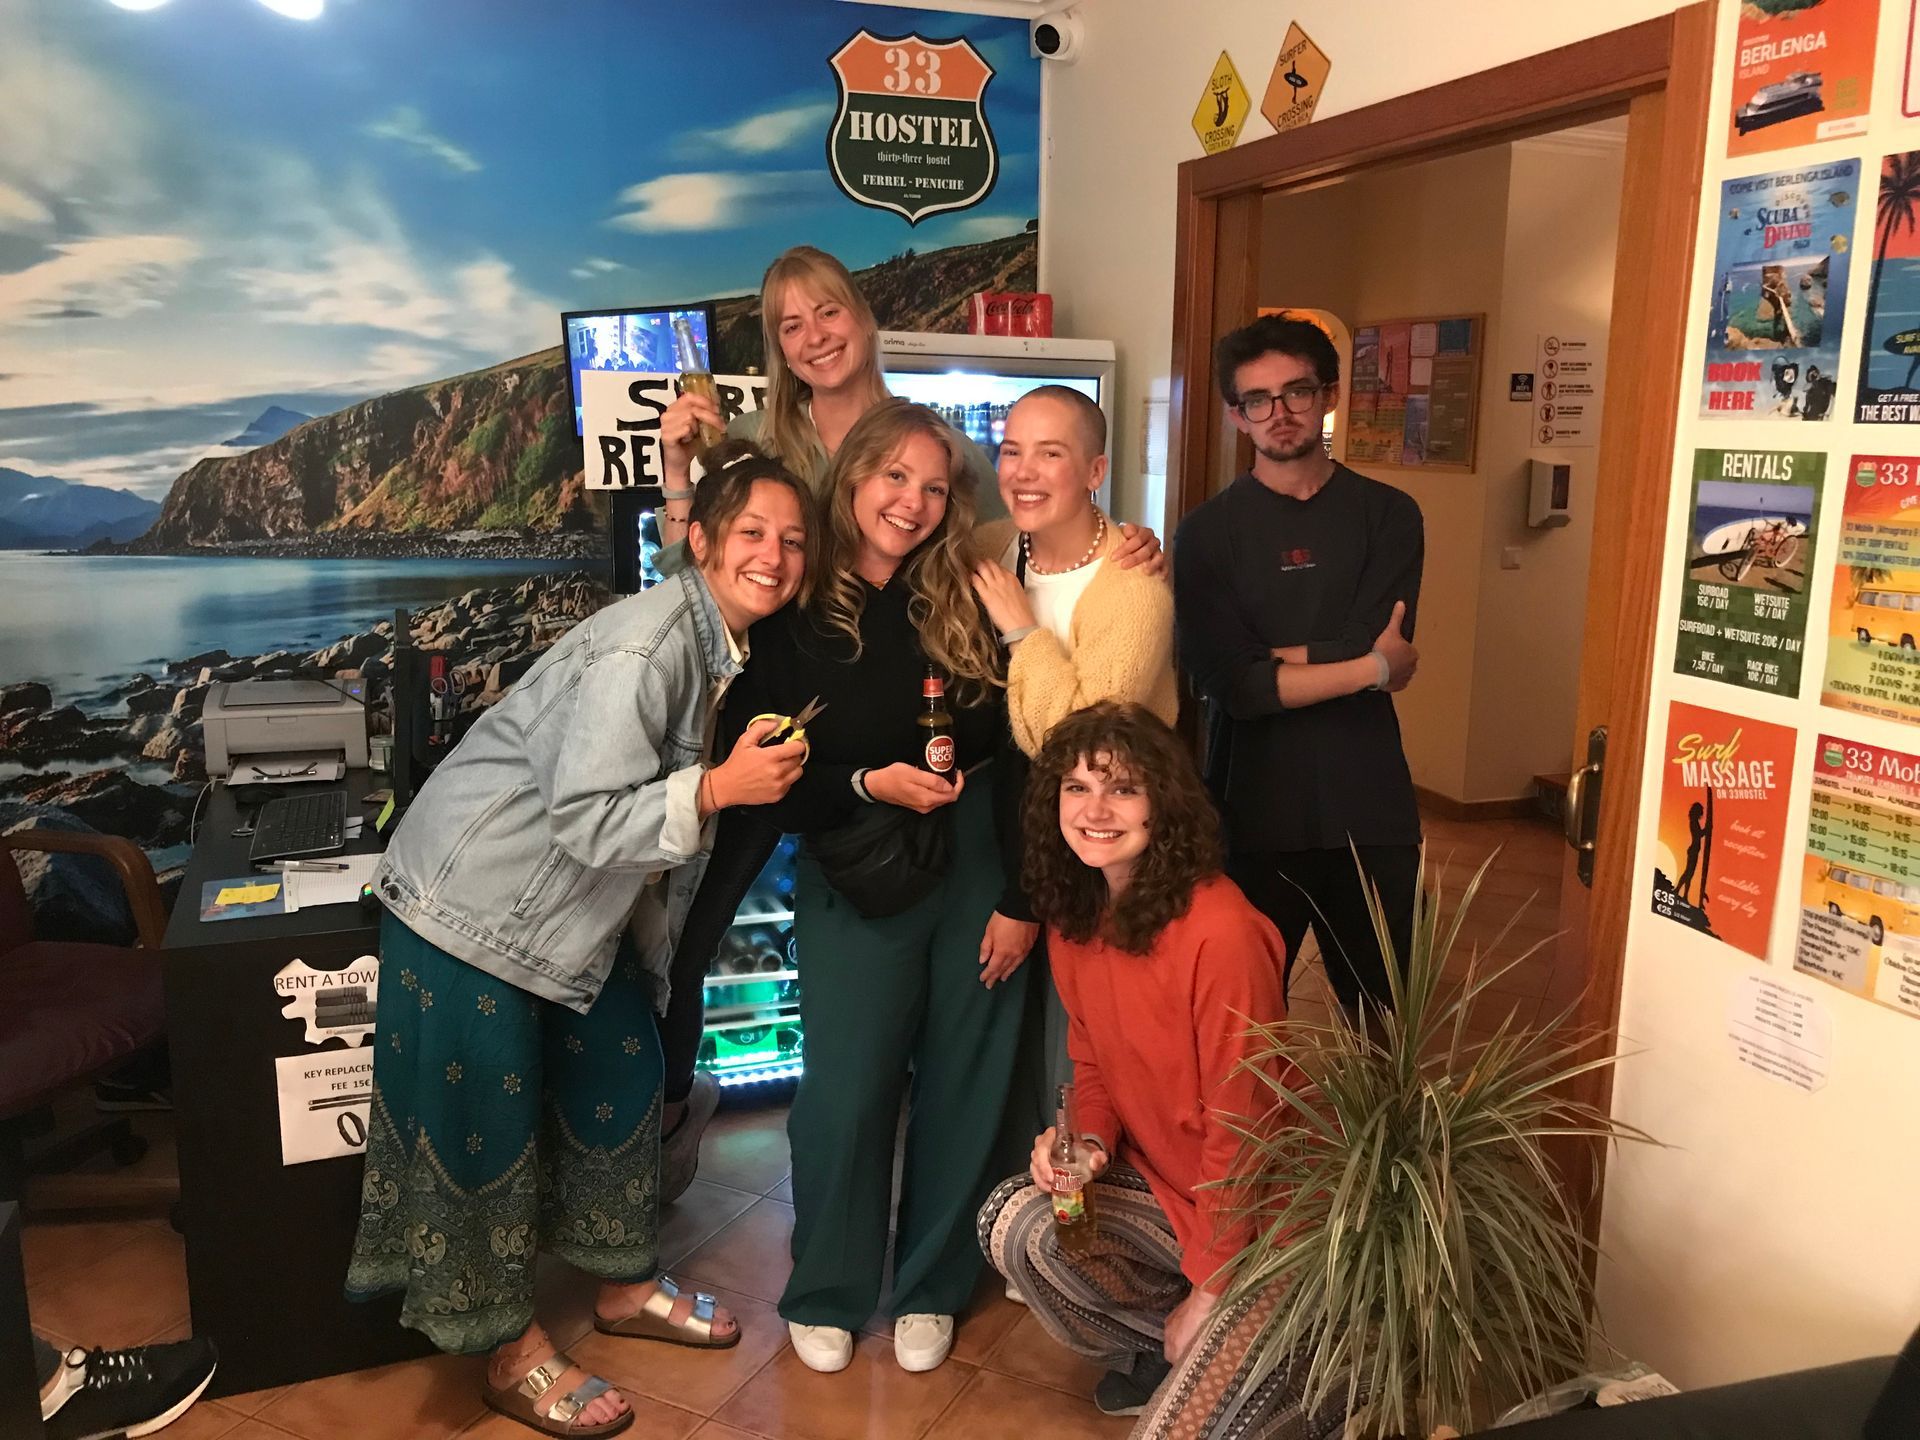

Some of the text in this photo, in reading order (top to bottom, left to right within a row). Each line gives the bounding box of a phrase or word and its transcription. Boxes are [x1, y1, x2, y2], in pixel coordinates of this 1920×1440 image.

[1280, 39, 1307, 66] SURFER
[1739, 31, 1827, 67] BERLENGA
[883, 47, 941, 95] 33
[1211, 74, 1232, 91] SLOTH
[1277, 95, 1313, 127] CROSSING
[849, 110, 978, 148] HOSTEL
[1204, 124, 1235, 144] CROSSING
[877, 151, 951, 165] thirty-three hostel
[862, 174, 907, 187] FERREL
[914, 177, 965, 190] PENICHE
[1775, 170, 1818, 187] BERLENGA
[1819, 164, 1854, 180] ISLAND
[1756, 207, 1799, 231] SCUBA
[1707, 361, 1763, 382] BOOK
[616, 378, 769, 431] SR
[1708, 390, 1756, 410] HERE
[1877, 393, 1893, 403] GET
[1860, 404, 1880, 421] THE
[1880, 404, 1909, 421] BEST
[598, 435, 667, 487] RE
[1722, 452, 1794, 481] RENTALS
[1880, 462, 1908, 486] 33
[1715, 598, 1729, 610] DAY
[1754, 593, 1790, 609] WETSUITE
[1771, 608, 1788, 621] DAY
[1724, 627, 1761, 645] WETSUITE
[1761, 634, 1778, 648] 20€
[1785, 639, 1802, 653] DAY
[1701, 651, 1715, 662] BIKE
[1712, 663, 1725, 675] DAY
[1764, 663, 1779, 675] BIKE
[1870, 662, 1877, 671] 3
[1879, 664, 1905, 676] DAYS
[1765, 674, 1779, 686] DAY
[1869, 675, 1875, 683] 7
[1876, 677, 1902, 689] DAYS
[929, 745, 953, 755] SUPER
[930, 754, 953, 763] BOCK
[1672, 728, 1742, 775] Surf
[1845, 747, 1873, 772] 33
[1681, 760, 1776, 789] MASSAGE
[1728, 788, 1768, 800] 33HOSTEL
[1653, 888, 1675, 906] €35
[1656, 903, 1673, 916] €25
[275, 970, 377, 991] RENT A TOW
[304, 1068, 322, 1080] KEY
[331, 1079, 371, 1091] FEE 15€
